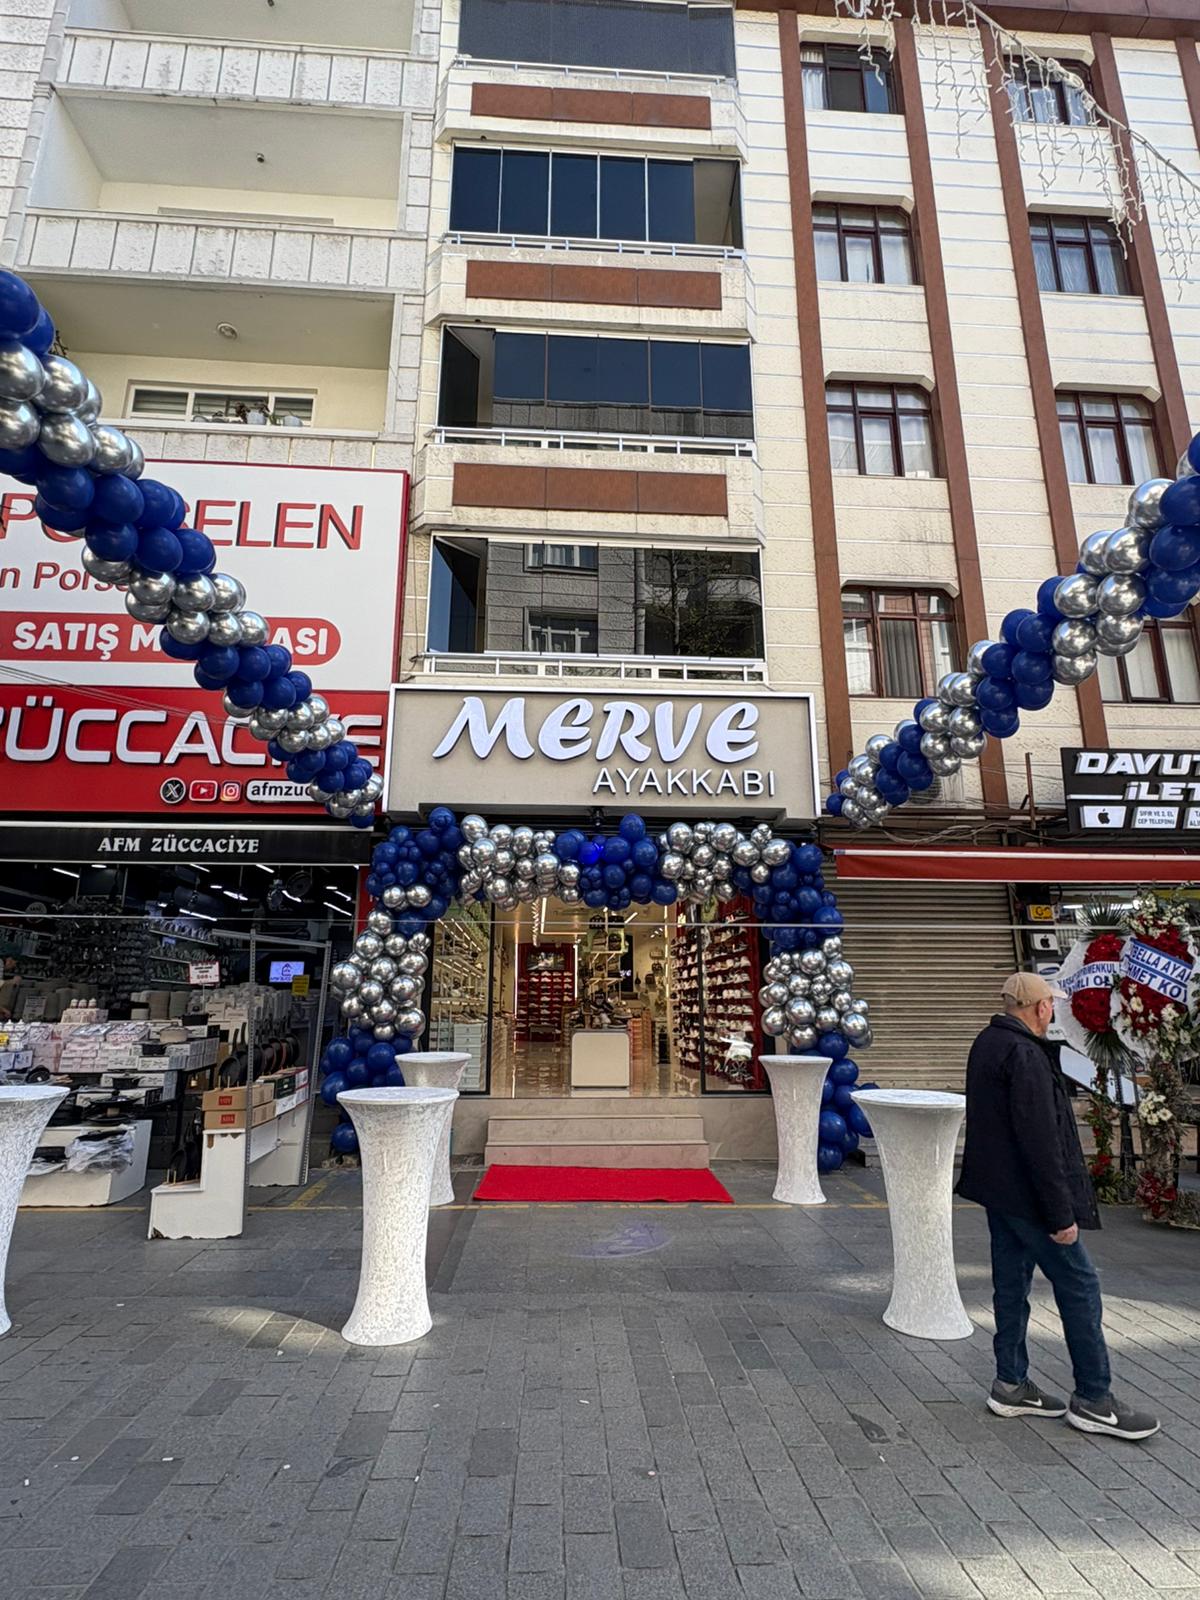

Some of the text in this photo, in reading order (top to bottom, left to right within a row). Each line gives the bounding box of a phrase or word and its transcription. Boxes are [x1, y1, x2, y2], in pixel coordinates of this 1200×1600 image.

[13, 621, 119, 660] SATIŞ
[0, 695, 382, 767] ÜCCACE
[432, 696, 760, 763] MERVE
[593, 767, 776, 797] AYAKKABI
[97, 834, 260, 853] AFM ZÜCCACİYE
